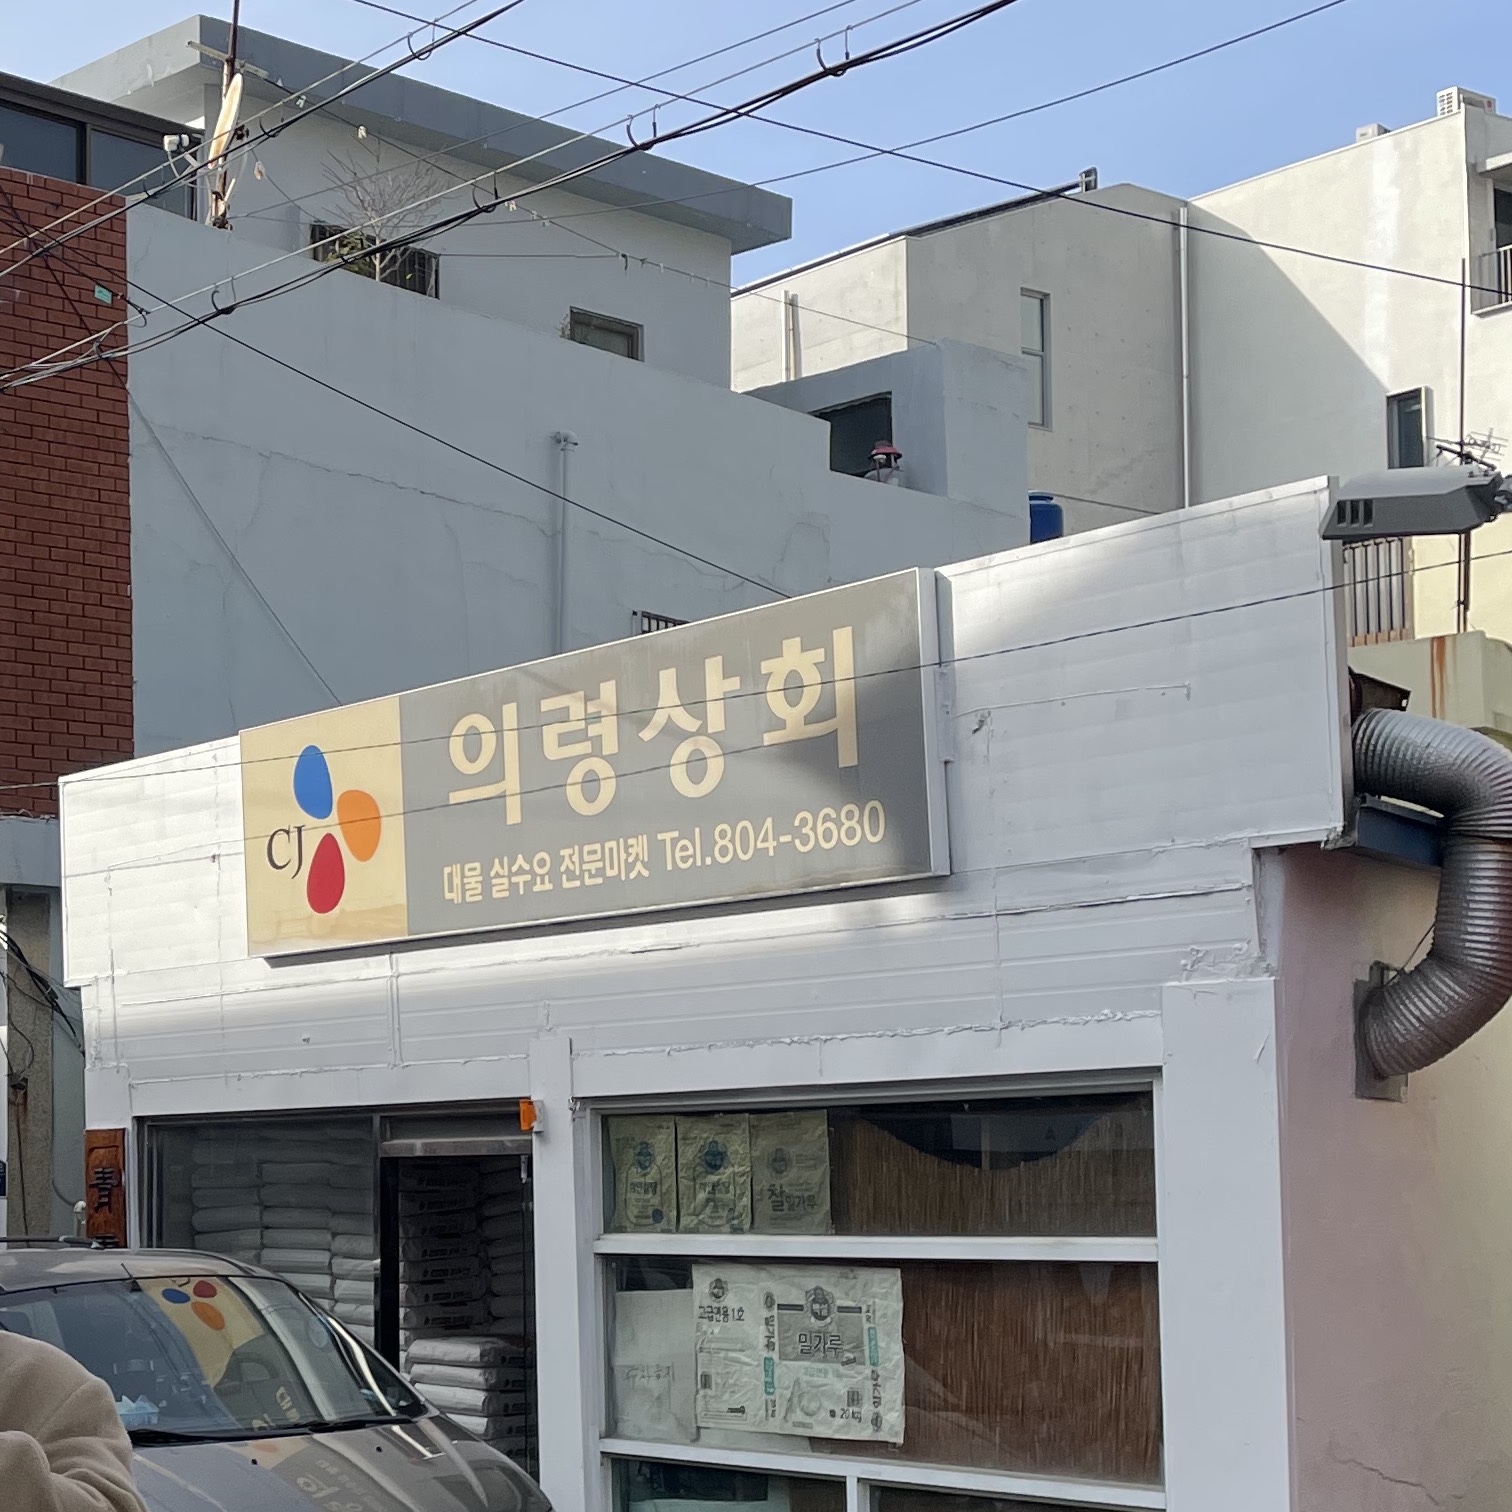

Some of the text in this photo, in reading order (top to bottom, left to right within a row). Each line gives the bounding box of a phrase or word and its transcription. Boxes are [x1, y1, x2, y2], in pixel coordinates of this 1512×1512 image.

[448, 626, 859, 825] 의령상회
[267, 824, 306, 879] CJ
[443, 862, 483, 904] 대물
[490, 851, 553, 899] 실수요
[559, 834, 650, 889] 전문마켓
[798, 1332, 844, 1357] 밀가루
